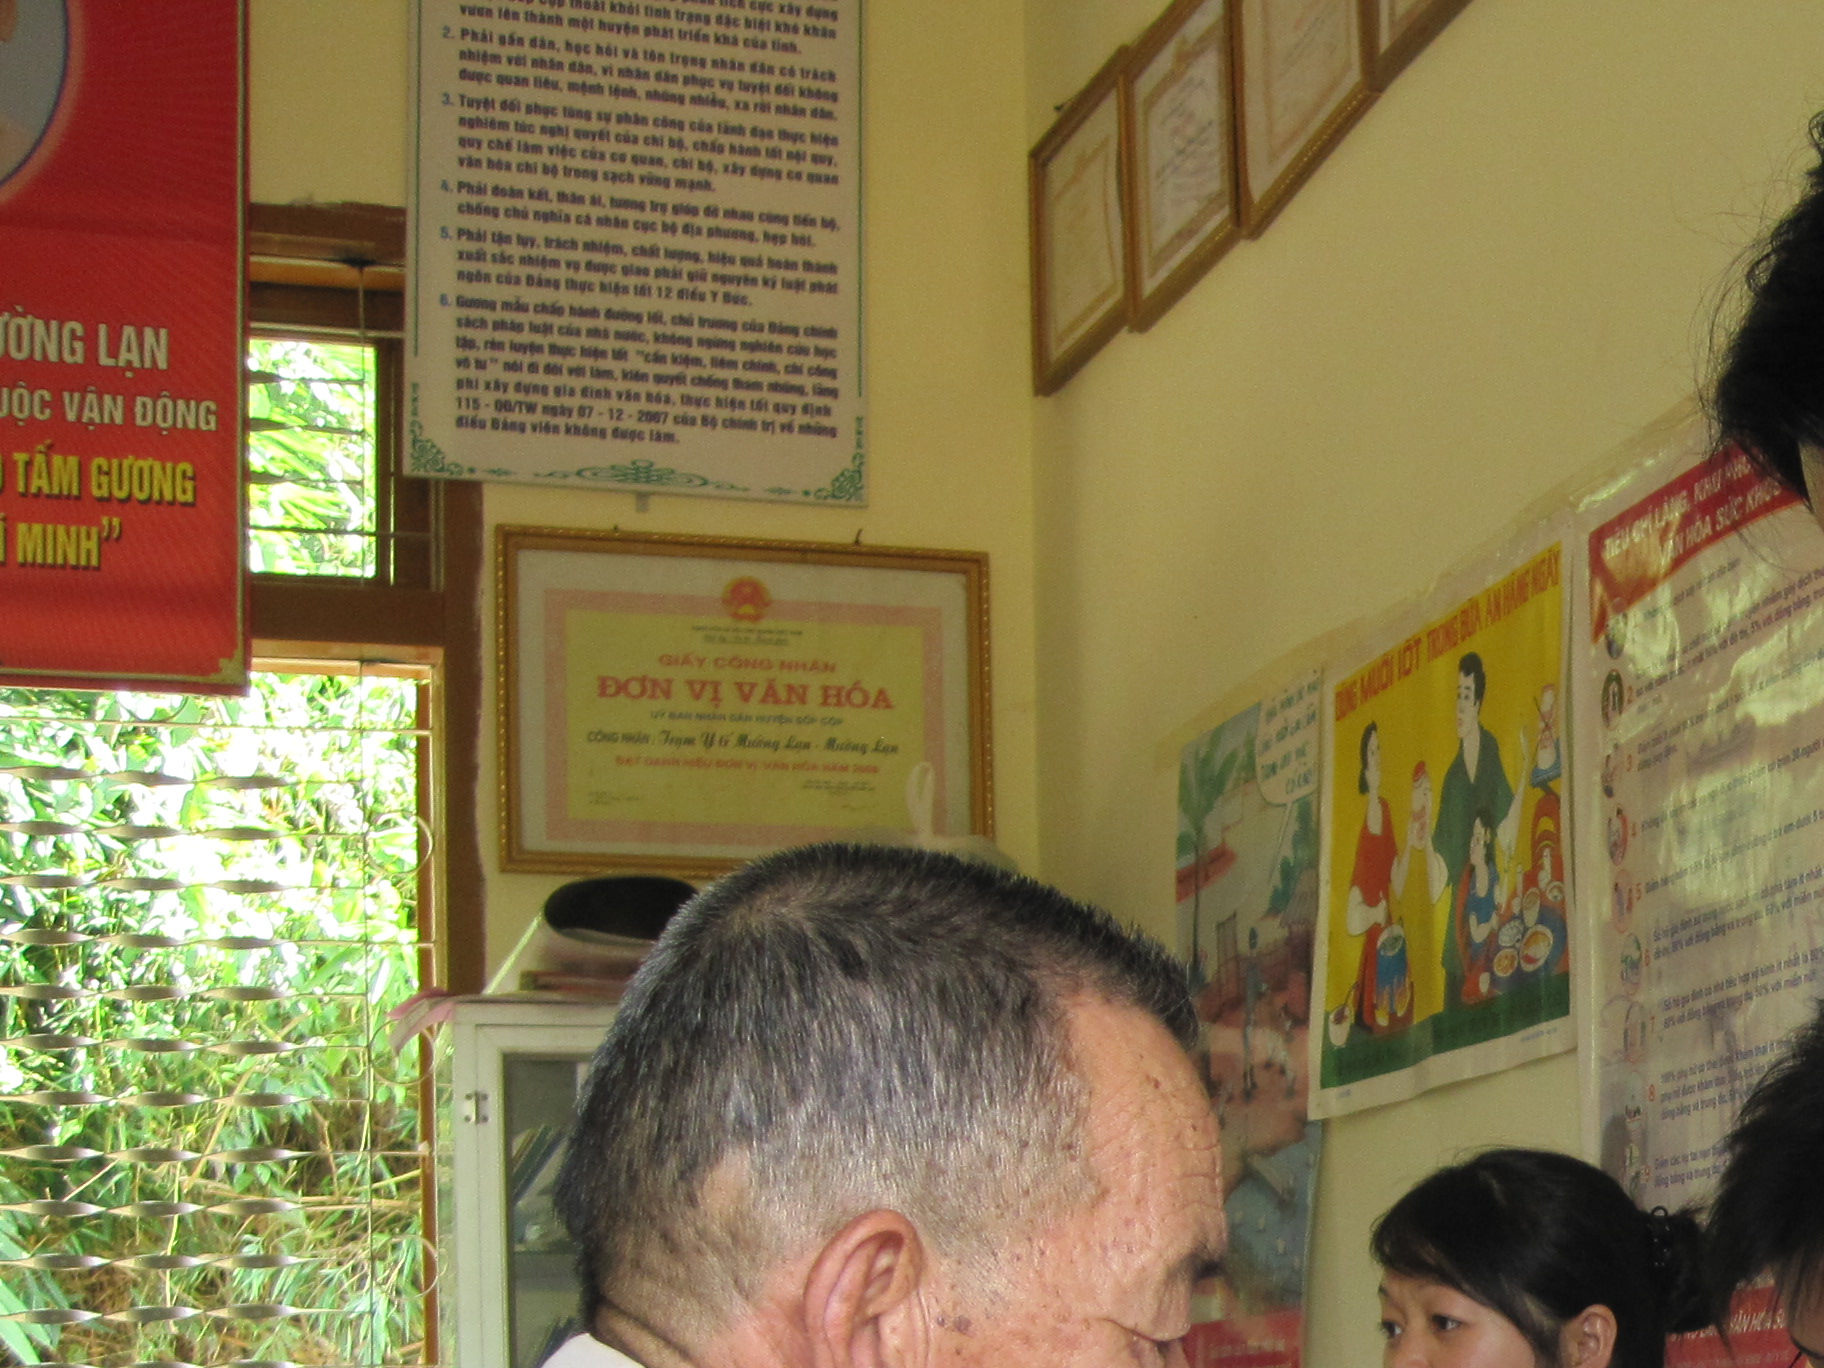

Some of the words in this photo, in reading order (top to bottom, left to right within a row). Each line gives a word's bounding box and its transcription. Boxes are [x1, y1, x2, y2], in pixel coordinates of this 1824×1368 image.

[656, 286, 672, 299] 12
[98, 323, 169, 378] LẠN
[62, 386, 124, 431] VẬN
[134, 391, 217, 435] ĐỘNG
[455, 396, 480, 410] 115
[608, 407, 623, 421] 12
[13, 440, 81, 496] TẤM
[90, 454, 195, 504] GƯƠNG
[597, 674, 674, 700] ĐƠN
[684, 678, 723, 709] VỊ
[734, 677, 810, 706] VĂN
[820, 680, 895, 710] HÓA
